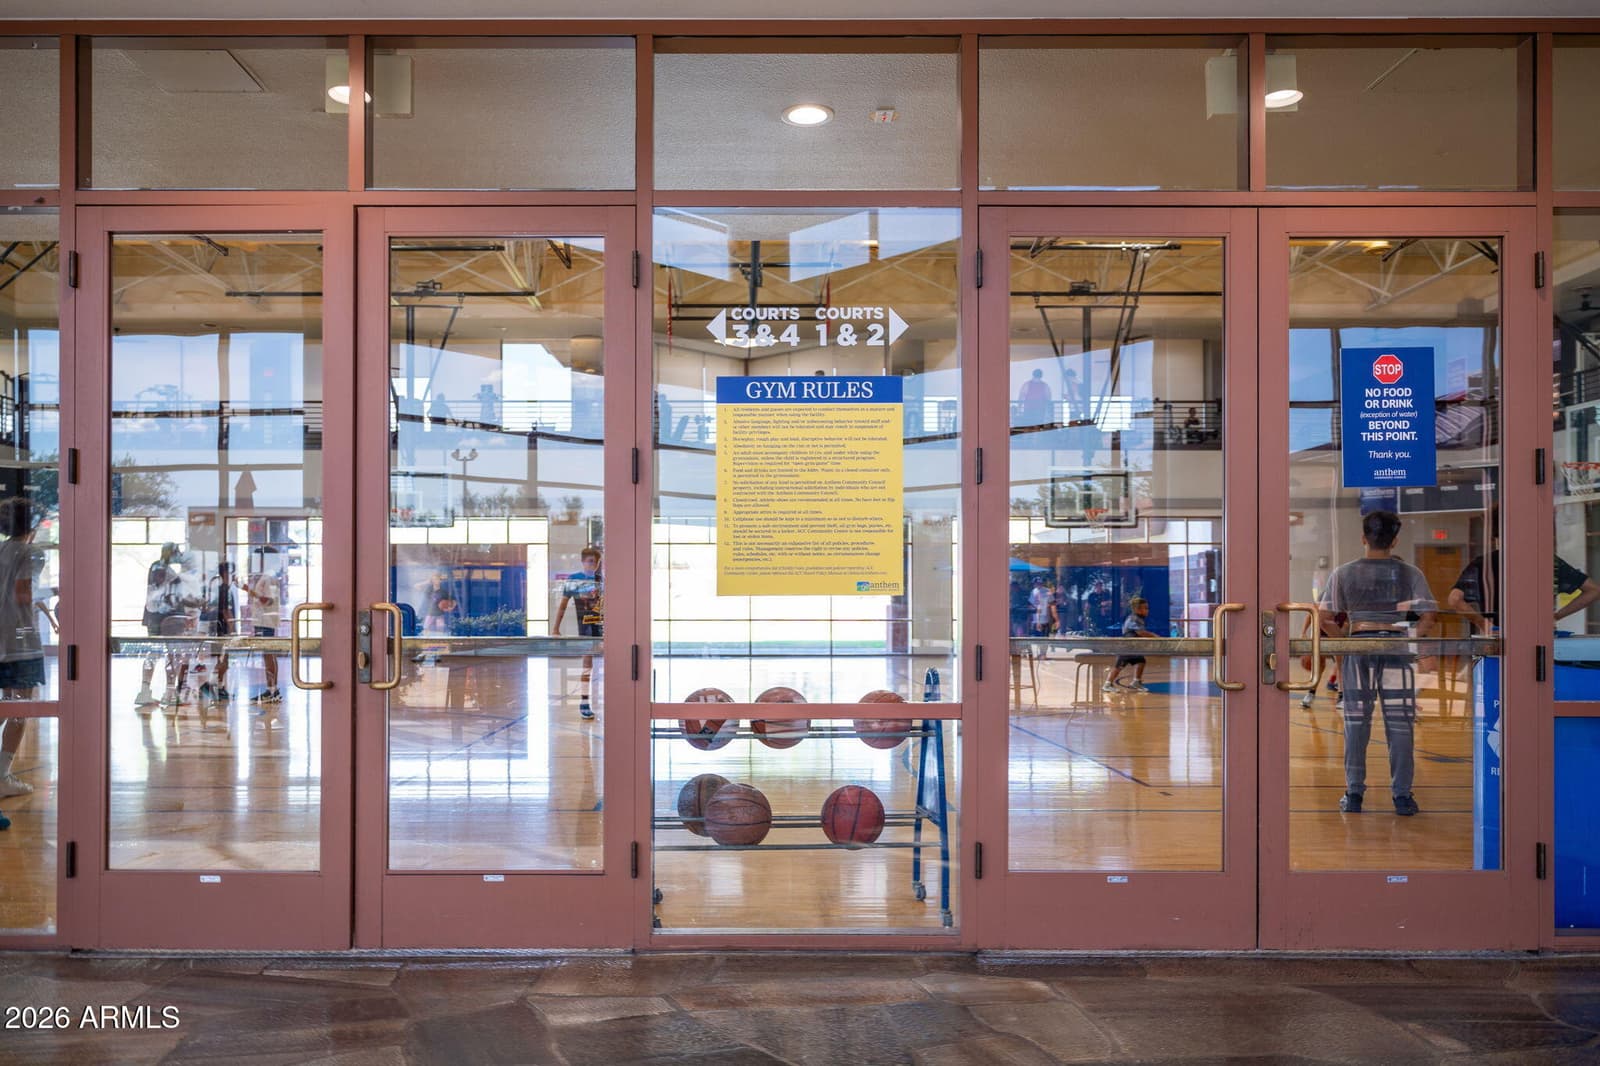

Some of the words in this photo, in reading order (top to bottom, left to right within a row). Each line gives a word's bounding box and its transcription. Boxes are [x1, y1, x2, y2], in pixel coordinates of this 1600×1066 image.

[731, 307, 800, 320] COURTS
[815, 307, 884, 320] COURTS
[732, 324, 750, 346] 3
[754, 324, 775, 346] &
[780, 324, 800, 346] 4
[816, 324, 828, 346] 1
[836, 324, 858, 346] &
[866, 324, 885, 346] 2
[1374, 364, 1401, 375] STOP
[746, 382, 796, 399] GYM
[802, 381, 873, 399] RULES
[1365, 388, 1380, 398] NO
[1384, 388, 1412, 397] FOOD
[1365, 400, 1380, 408] OR
[1382, 399, 1413, 408] DRINK
[1368, 420, 1410, 430] BEYOND
[1360, 432, 1383, 441] THIS
[1386, 432, 1418, 441] POINT.
[1368, 450, 1393, 459] Thank
[1394, 451, 1411, 460] you.
[1374, 468, 1406, 476] anthem
